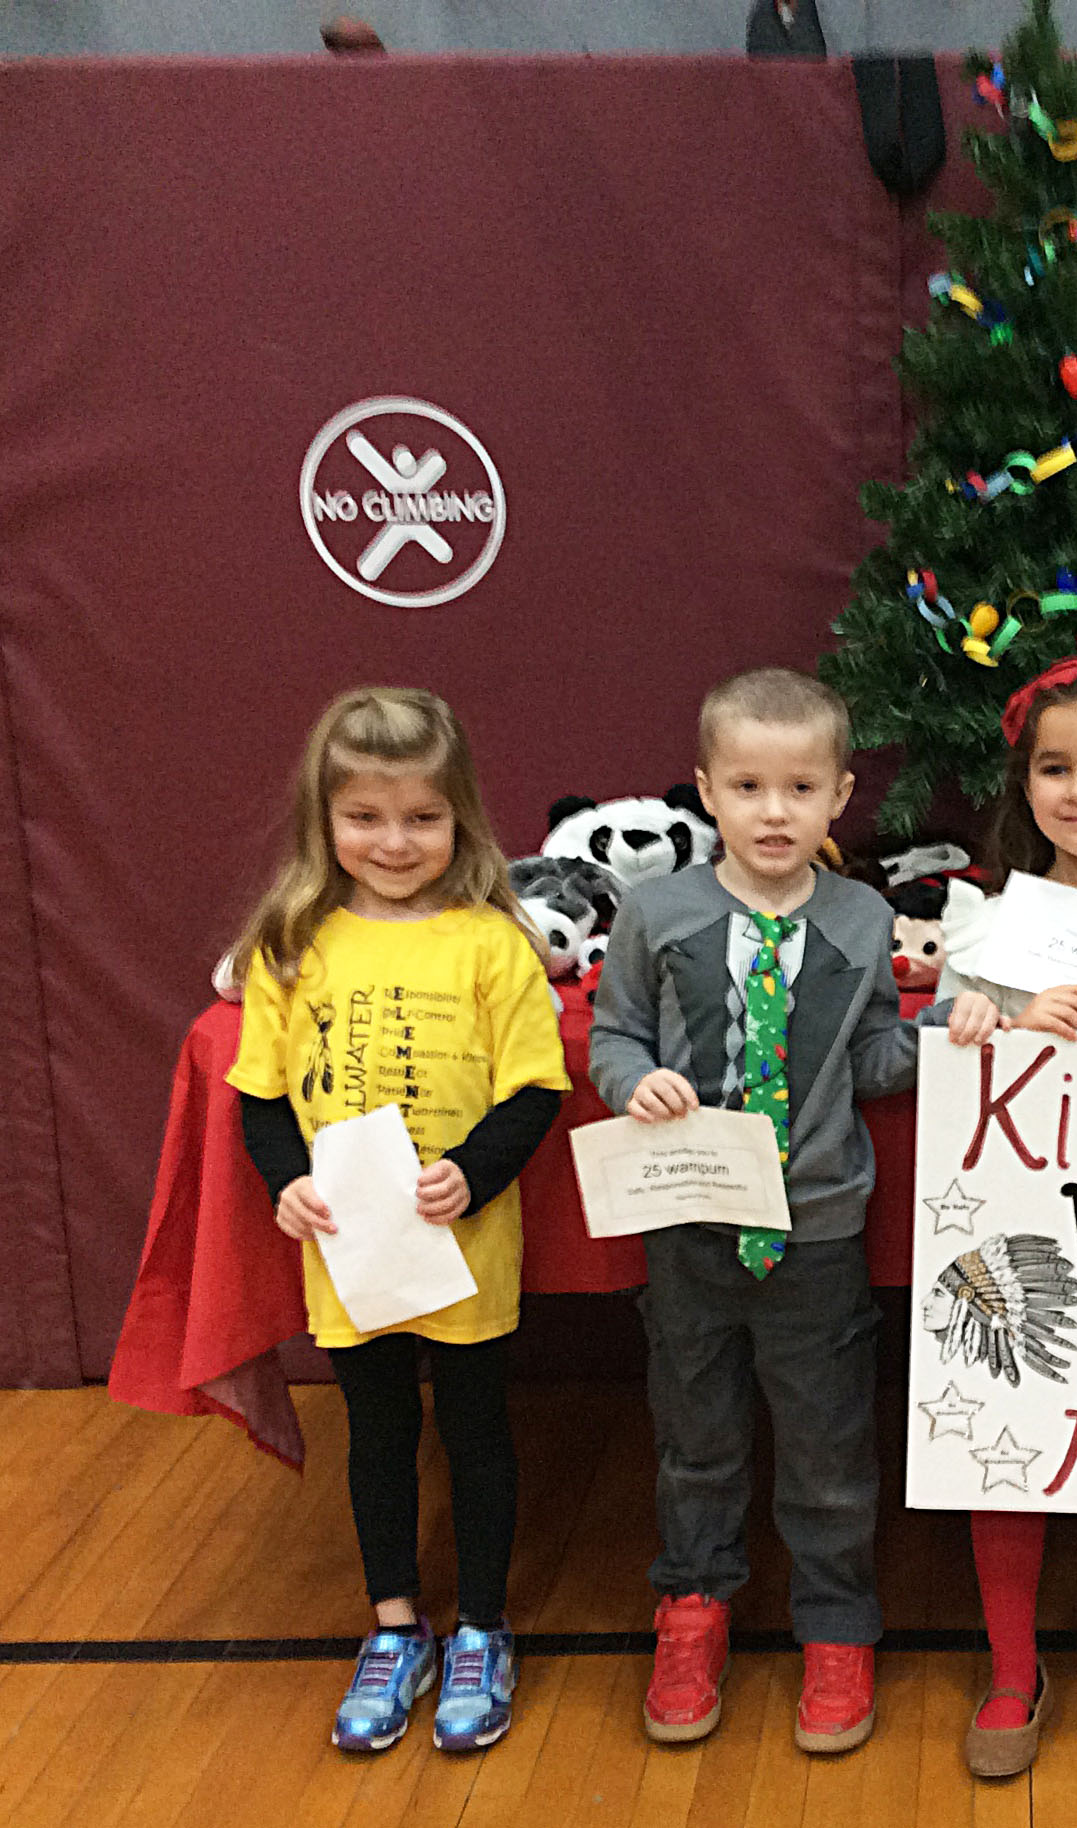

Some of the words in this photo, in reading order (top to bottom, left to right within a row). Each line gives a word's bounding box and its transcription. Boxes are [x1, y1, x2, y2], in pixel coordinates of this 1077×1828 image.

[313, 489, 358, 522] NO
[362, 489, 495, 522] CLIMBING
[642, 1164, 662, 1179] 25
[665, 1162, 730, 1176] wampum
